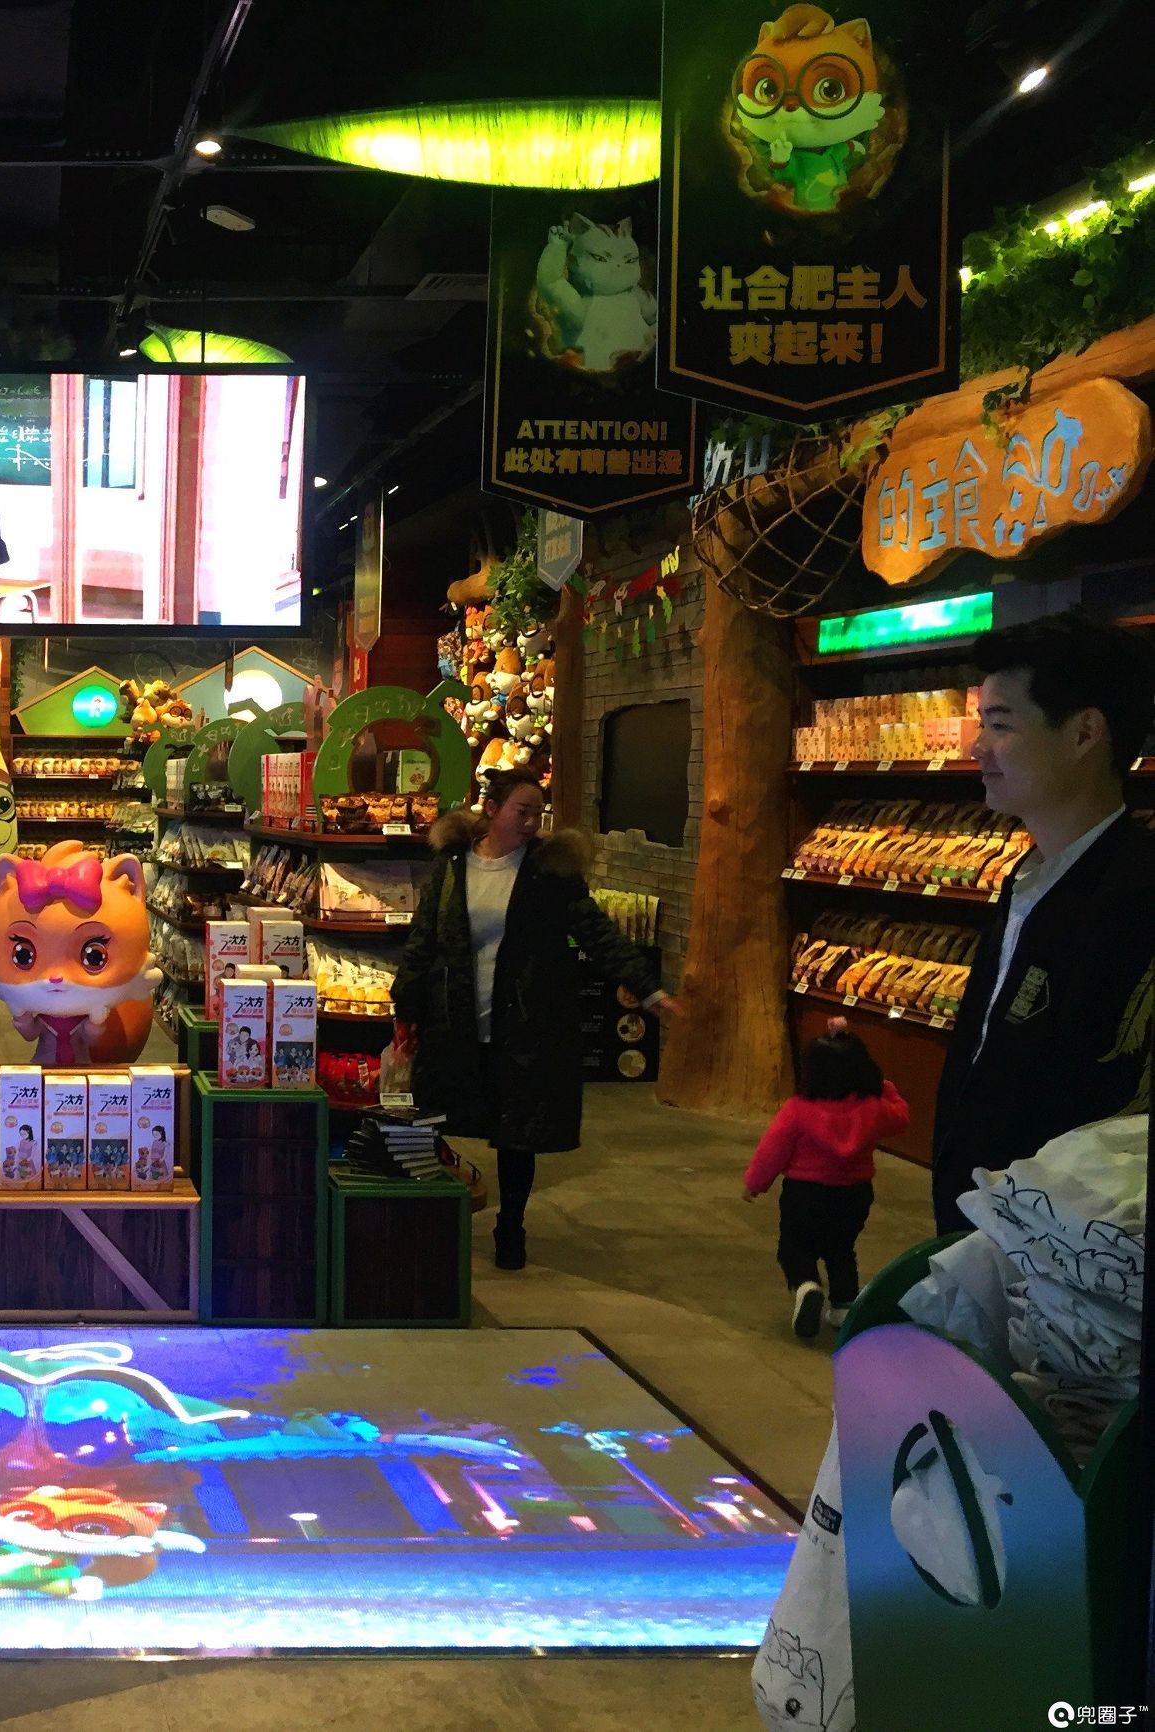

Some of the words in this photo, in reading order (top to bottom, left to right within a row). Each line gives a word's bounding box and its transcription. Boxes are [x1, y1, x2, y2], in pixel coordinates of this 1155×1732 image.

[698, 263, 928, 311] 让合肥主人
[516, 418, 669, 441] ATTENTION!
